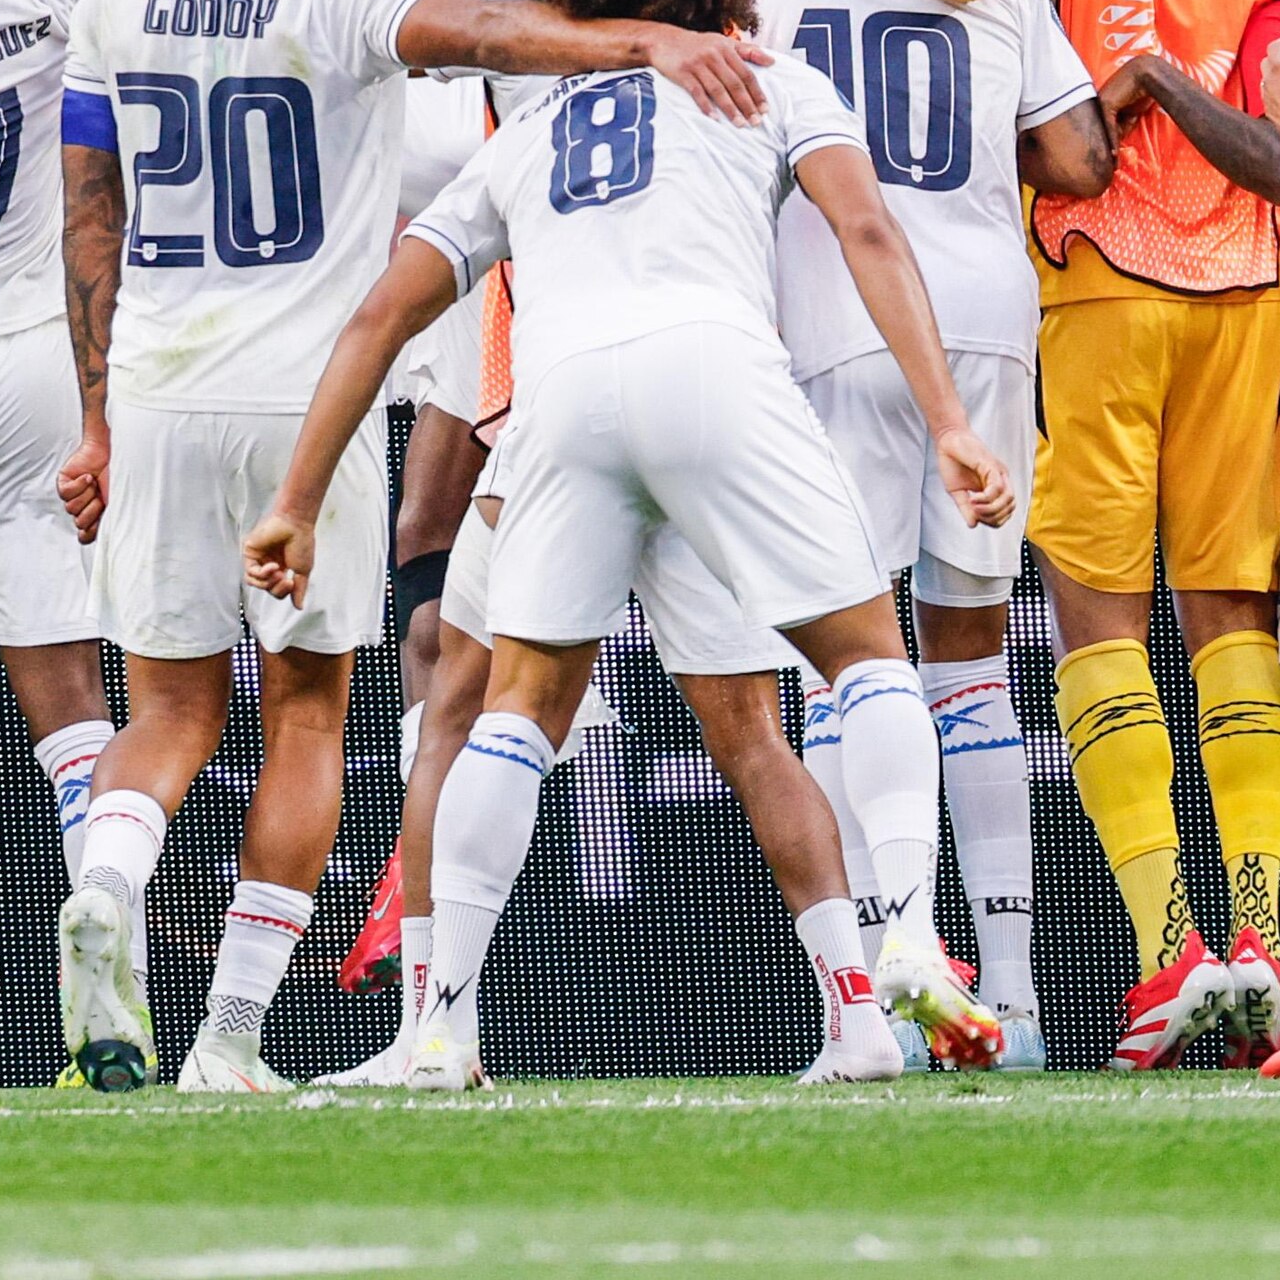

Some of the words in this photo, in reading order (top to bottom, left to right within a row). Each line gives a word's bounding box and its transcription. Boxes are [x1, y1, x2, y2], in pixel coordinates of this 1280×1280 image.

[117, 71, 325, 269] 20
[549, 71, 657, 215] 8
[790, 8, 972, 192] 10
